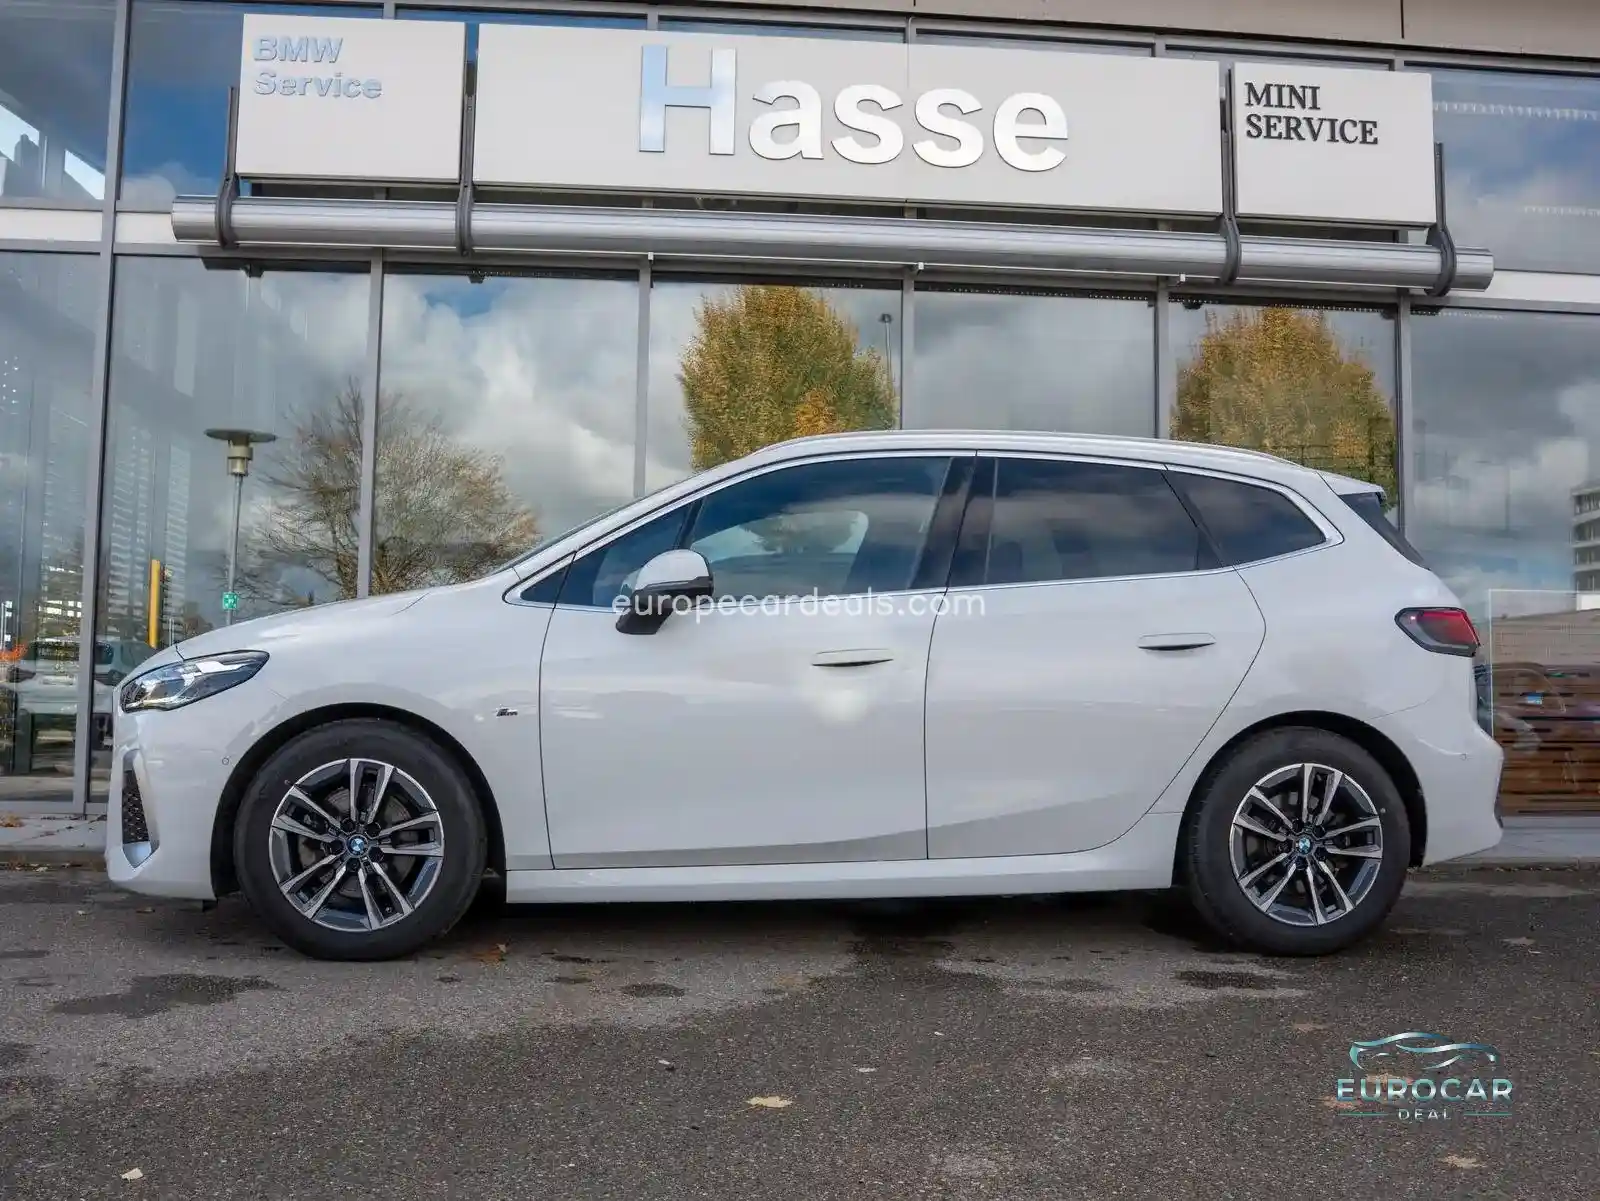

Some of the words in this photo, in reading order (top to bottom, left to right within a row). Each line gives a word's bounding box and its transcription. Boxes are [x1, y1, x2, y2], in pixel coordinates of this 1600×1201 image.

[253, 36, 343, 63] BMW
[253, 71, 382, 99] Service
[1244, 82, 1321, 110] MINI
[639, 45, 1069, 172] Hasse
[1245, 113, 1379, 145] SERVICE
